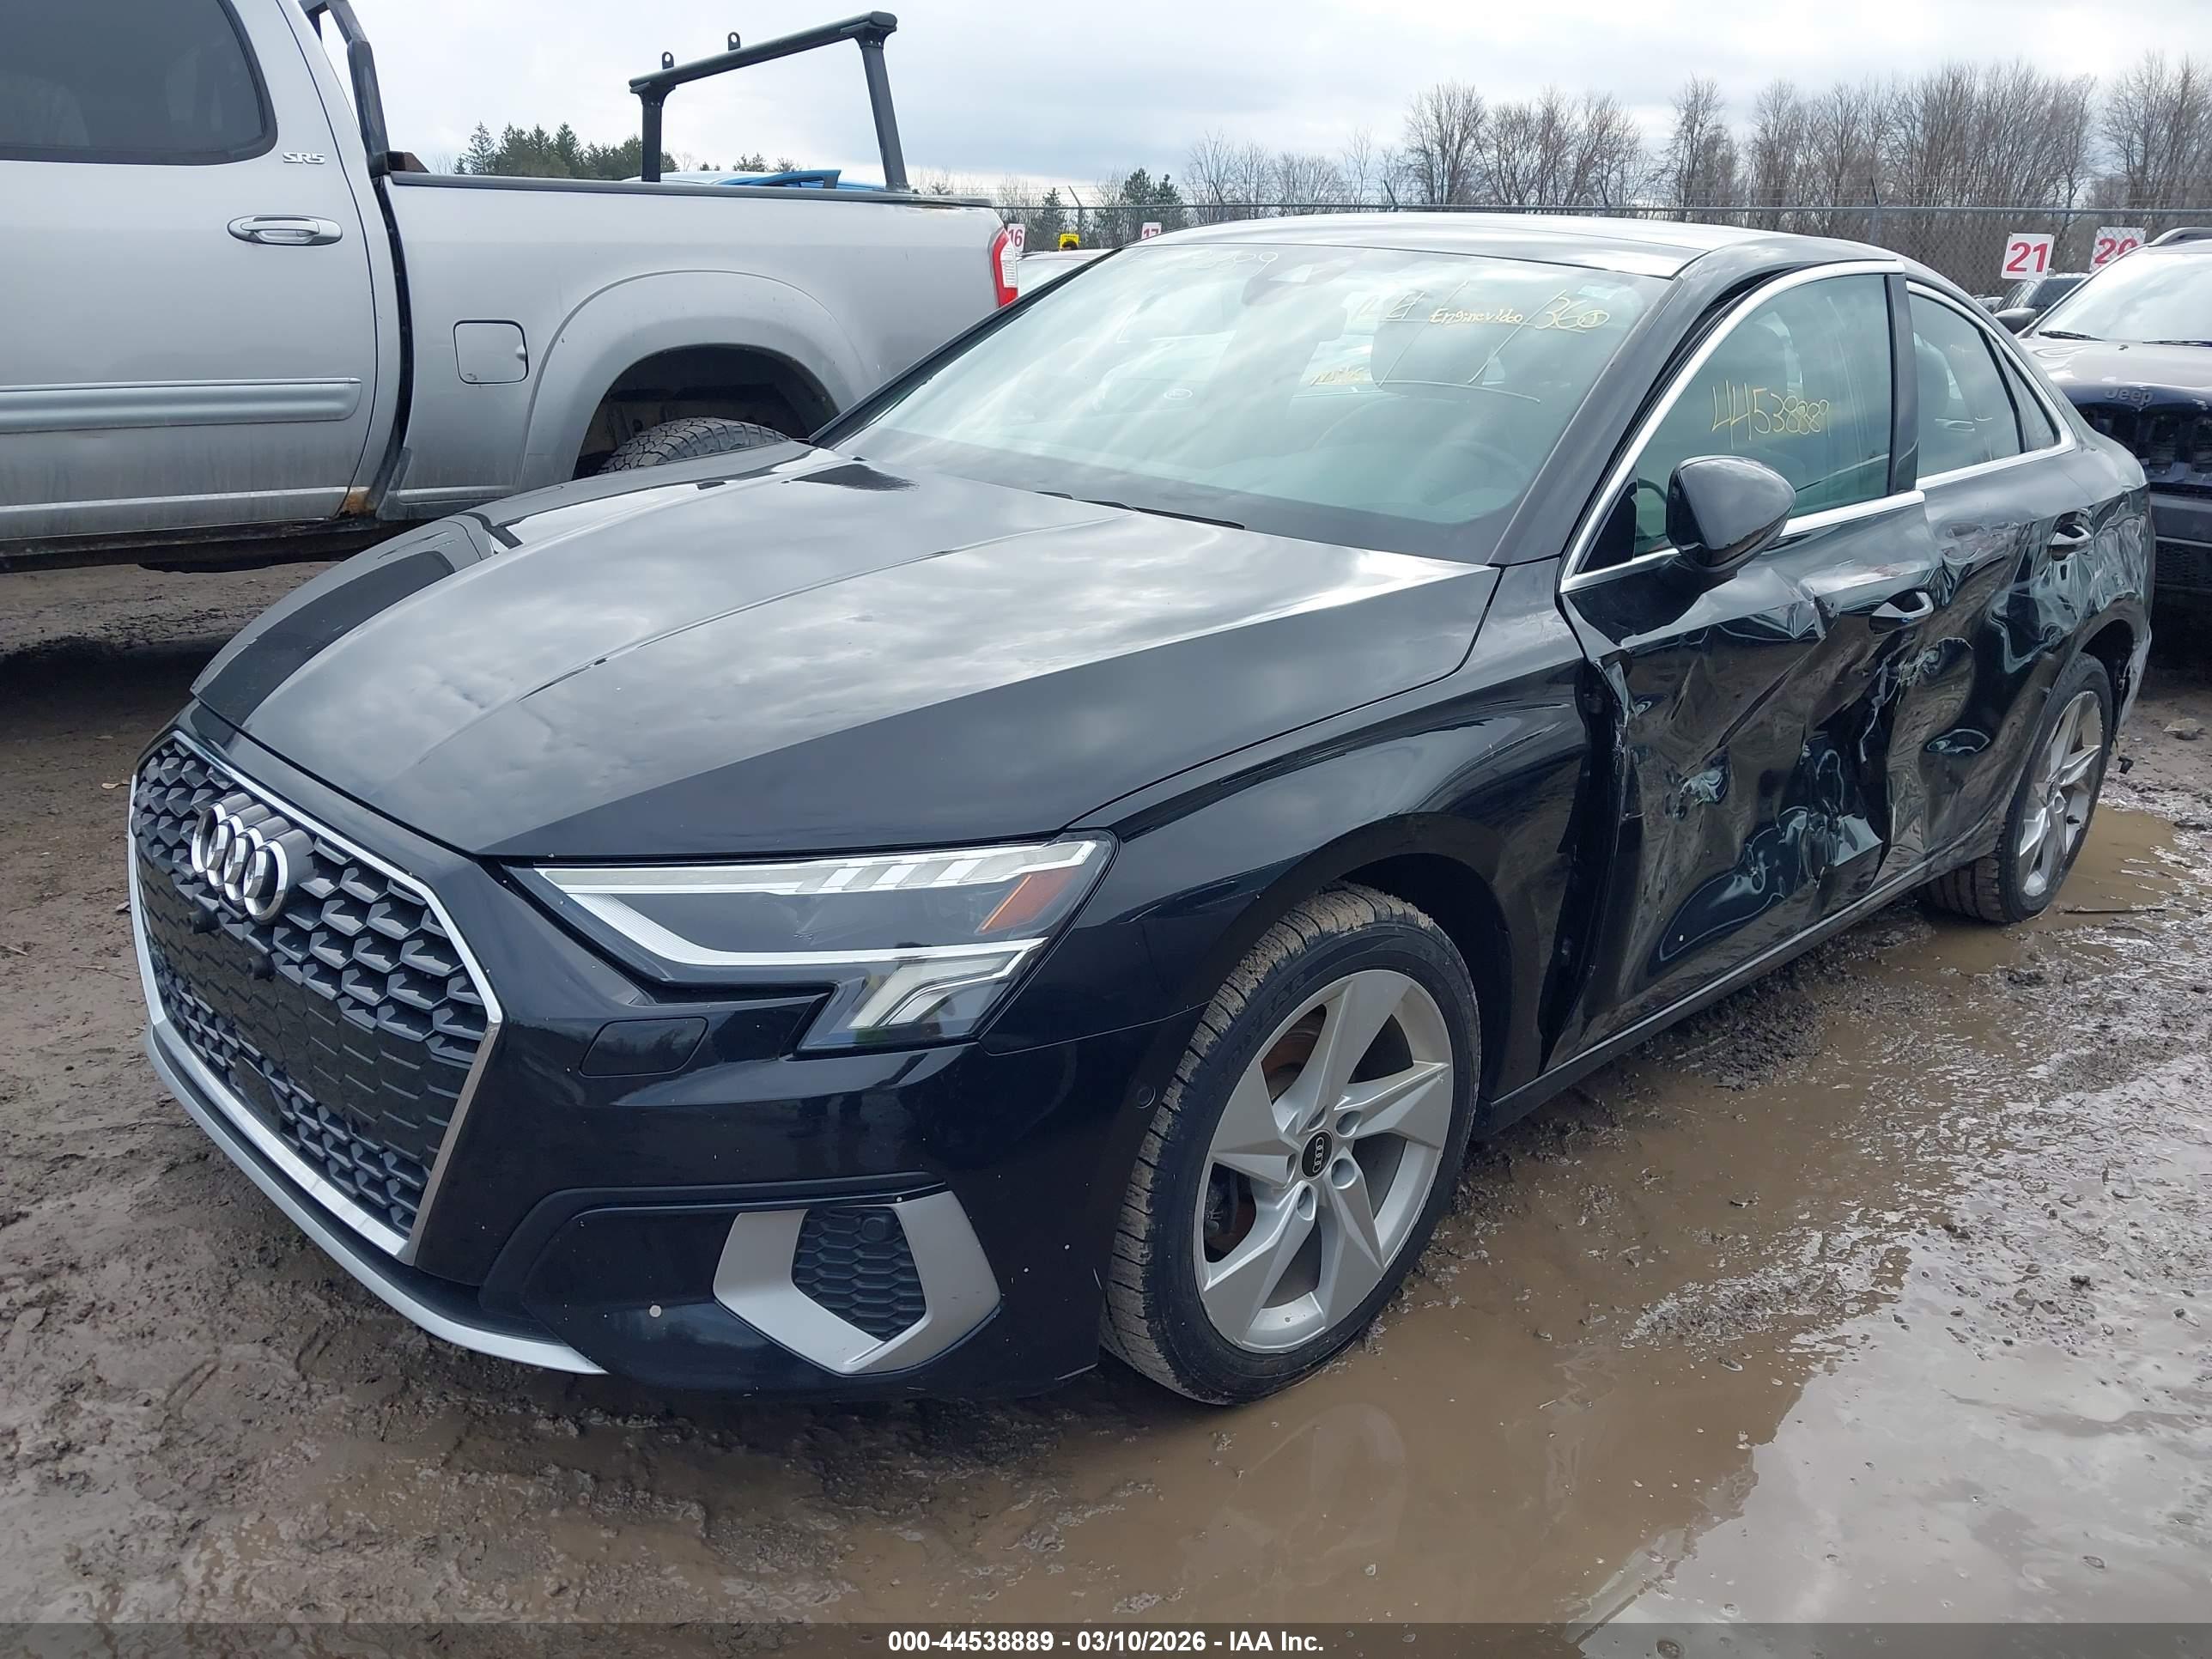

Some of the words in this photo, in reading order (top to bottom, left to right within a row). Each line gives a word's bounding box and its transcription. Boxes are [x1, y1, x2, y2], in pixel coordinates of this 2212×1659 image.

[283, 151, 325, 165] SR5
[1008, 228, 1024, 247] 16
[2005, 241, 2049, 273] 21
[2104, 387, 2154, 406] Jeep
[1711, 379, 1831, 450] 44538889
